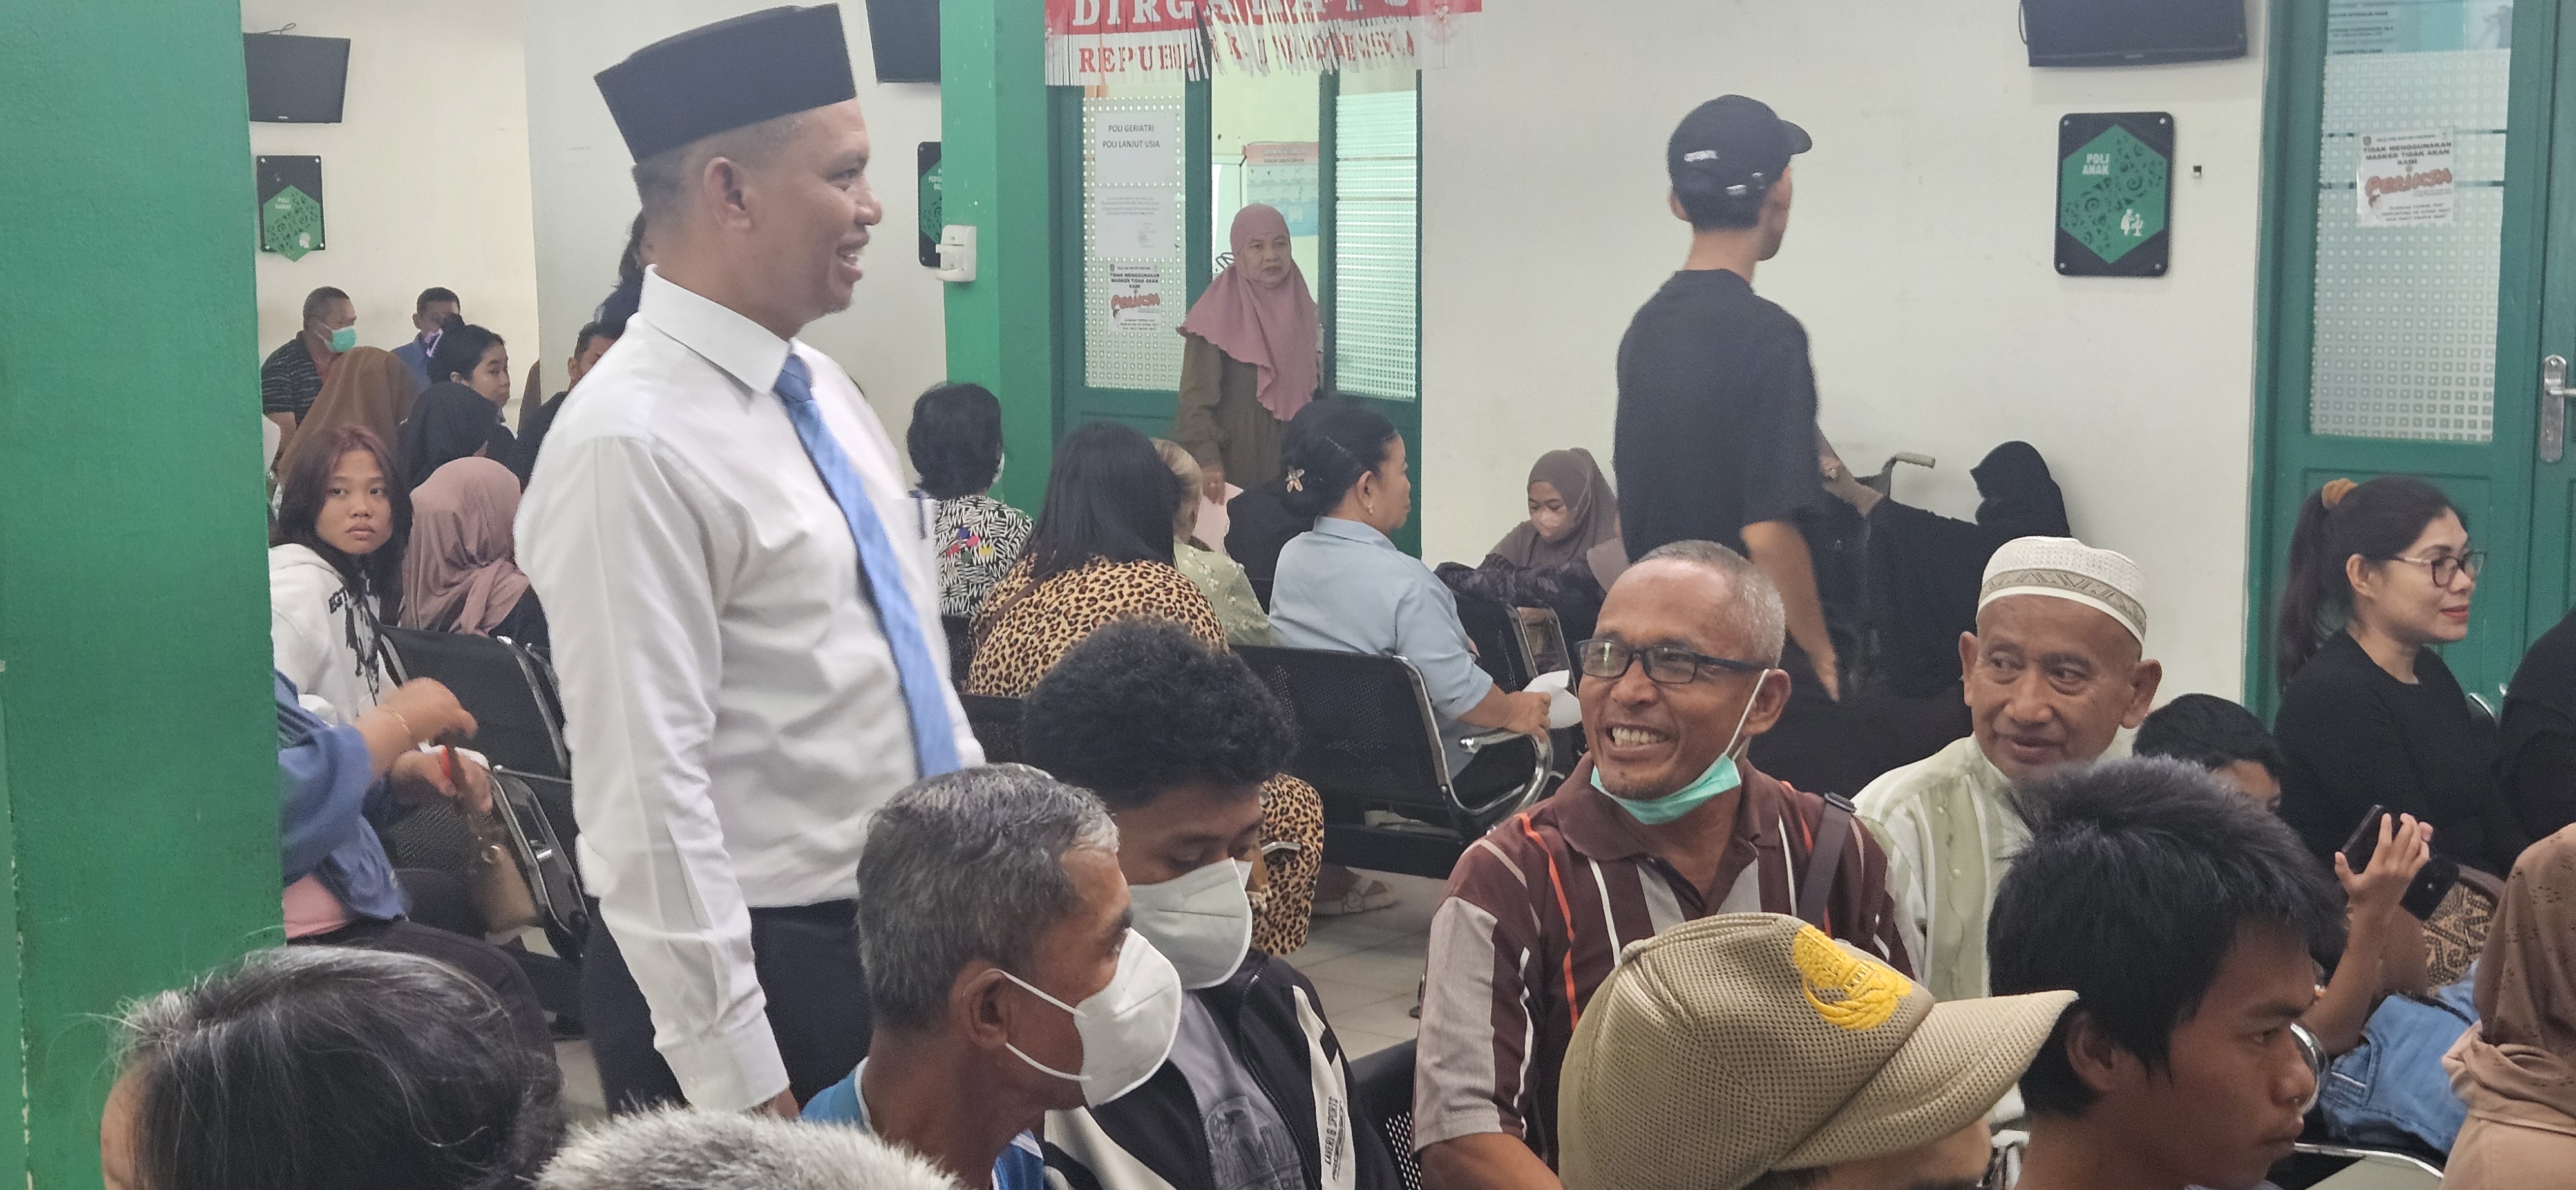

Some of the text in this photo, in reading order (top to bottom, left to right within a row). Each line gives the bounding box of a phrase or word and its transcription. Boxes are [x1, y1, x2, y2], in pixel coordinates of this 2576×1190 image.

[2389, 142, 2451, 151] MENGGUNAKAN
[2087, 153, 2110, 164] POLI
[2082, 164, 2109, 175] ANAK
[1328, 1096, 1338, 1128] SPORTS
